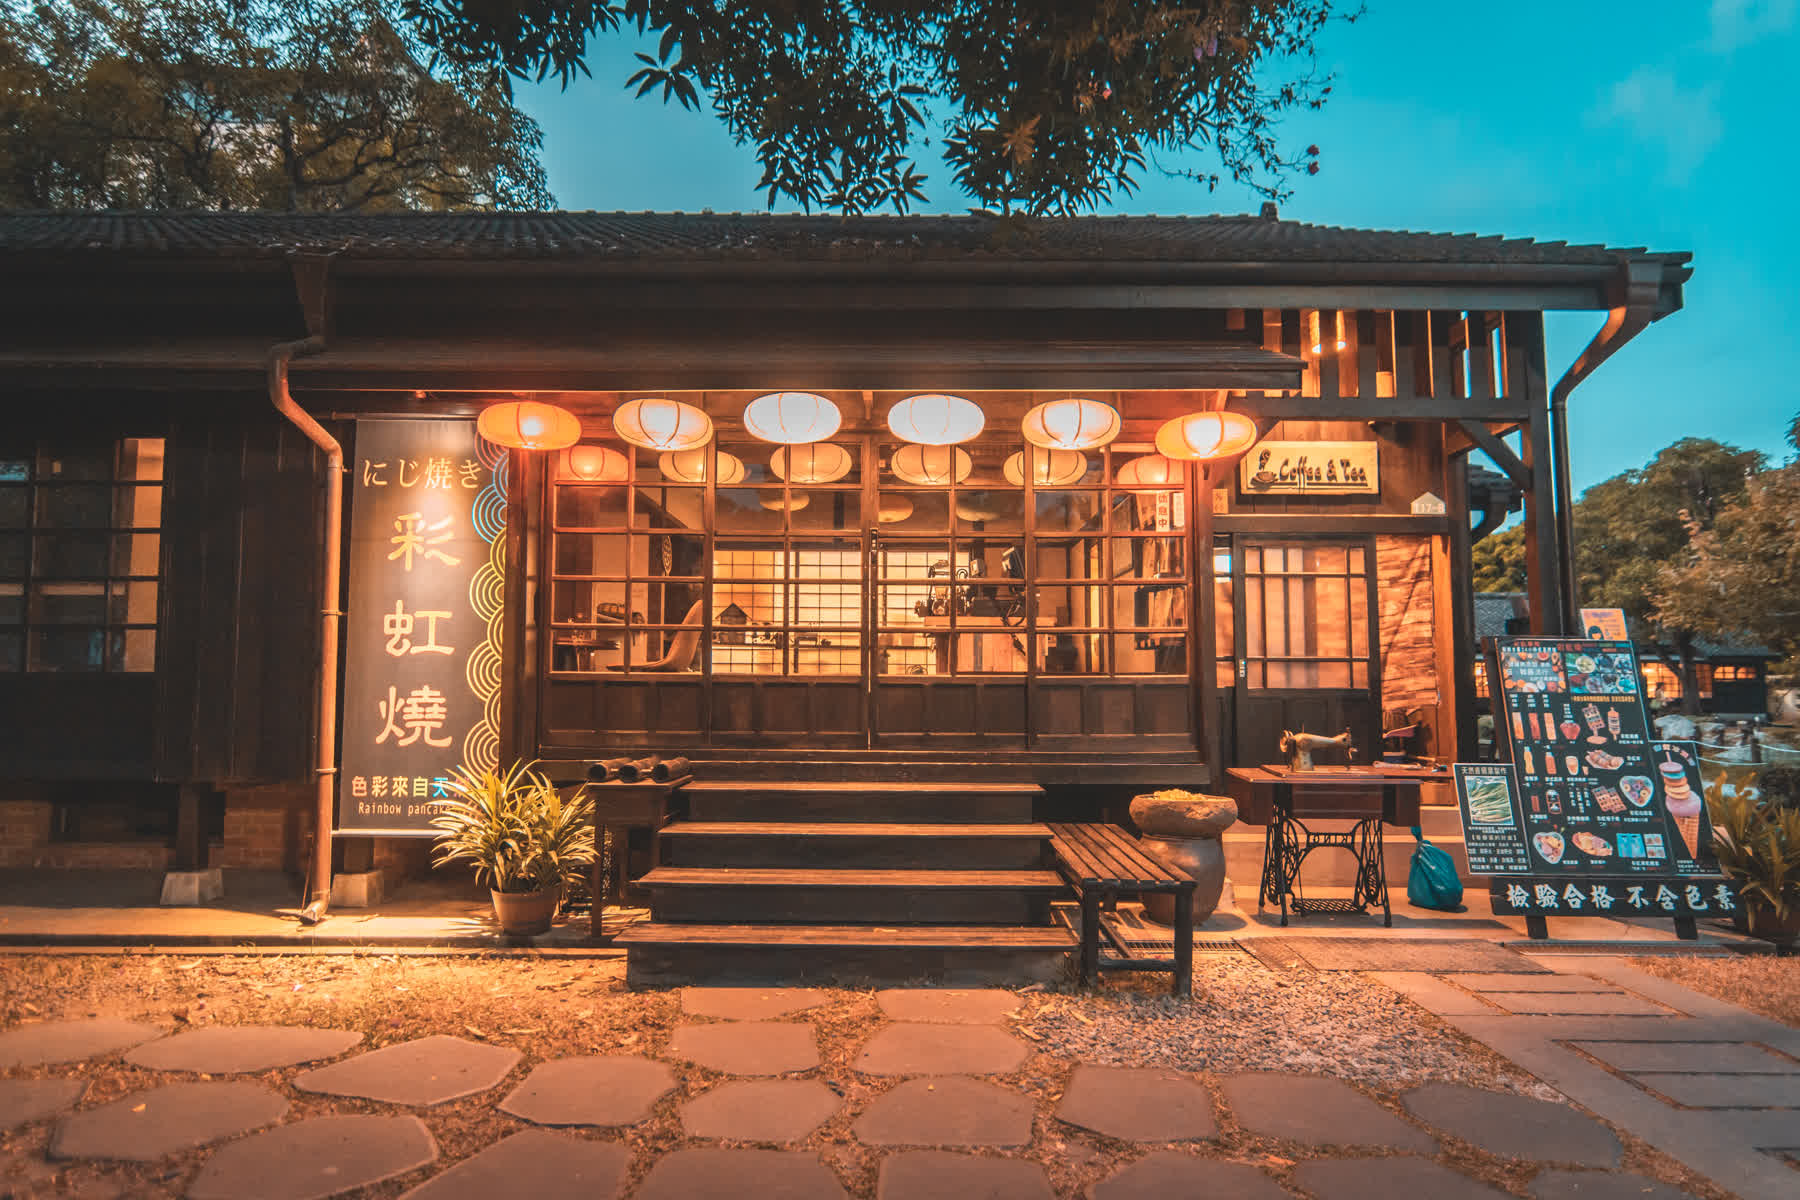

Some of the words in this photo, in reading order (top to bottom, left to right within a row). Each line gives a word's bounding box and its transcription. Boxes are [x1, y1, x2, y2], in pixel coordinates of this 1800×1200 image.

[362, 457, 481, 489] にじ焼き
[1279, 455, 1321, 490] Coffee
[1327, 459, 1338, 482] &
[1340, 458, 1368, 481] Tea
[375, 511, 461, 748] 彩虹燒
[351, 775, 471, 799] 色彩來自天
[358, 802, 402, 815] Rainbow
[1506, 883, 1615, 909] 檢驗合格
[1626, 884, 1737, 910] 不含色素
